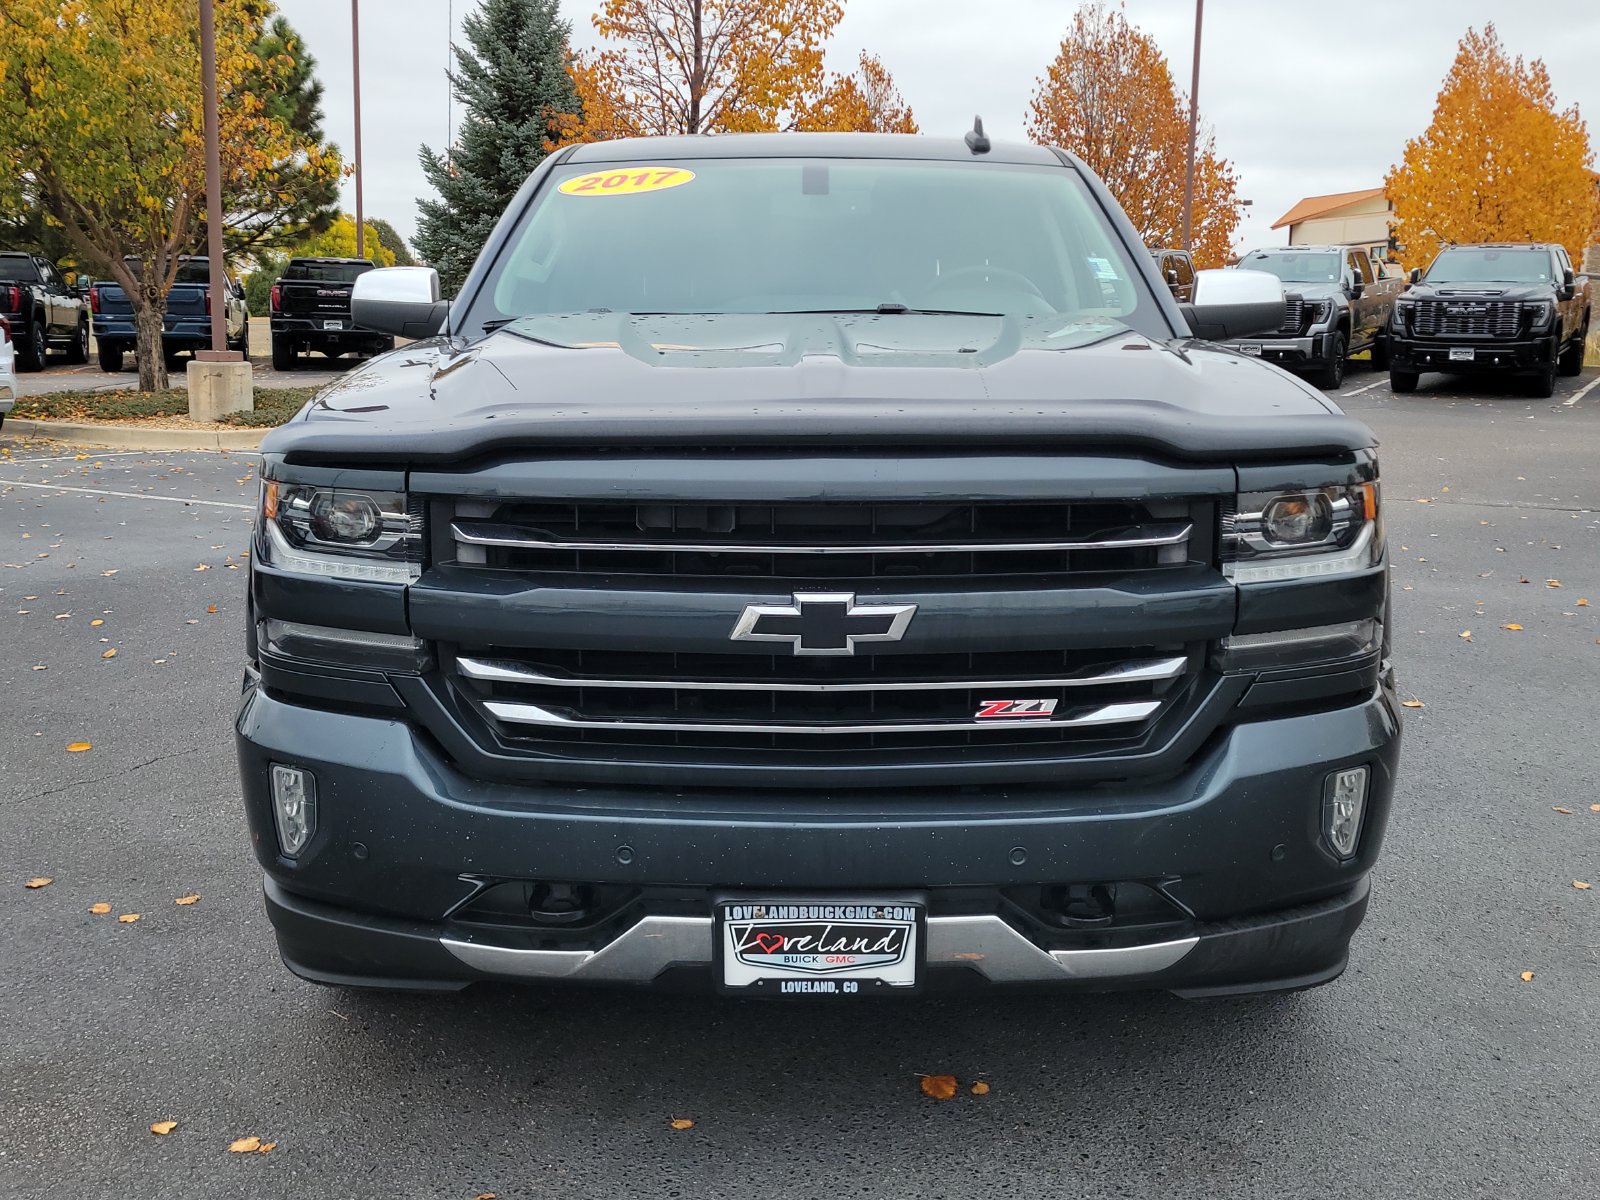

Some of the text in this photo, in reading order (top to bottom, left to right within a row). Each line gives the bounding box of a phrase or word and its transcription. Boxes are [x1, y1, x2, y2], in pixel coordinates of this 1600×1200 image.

[573, 171, 680, 192] 2017
[975, 699, 1059, 717] Z71
[724, 906, 916, 921] LOVELANDBUICKGMCCOM
[784, 955, 856, 964] BUICK GMC
[781, 981, 858, 994] LOVELAND, CO
